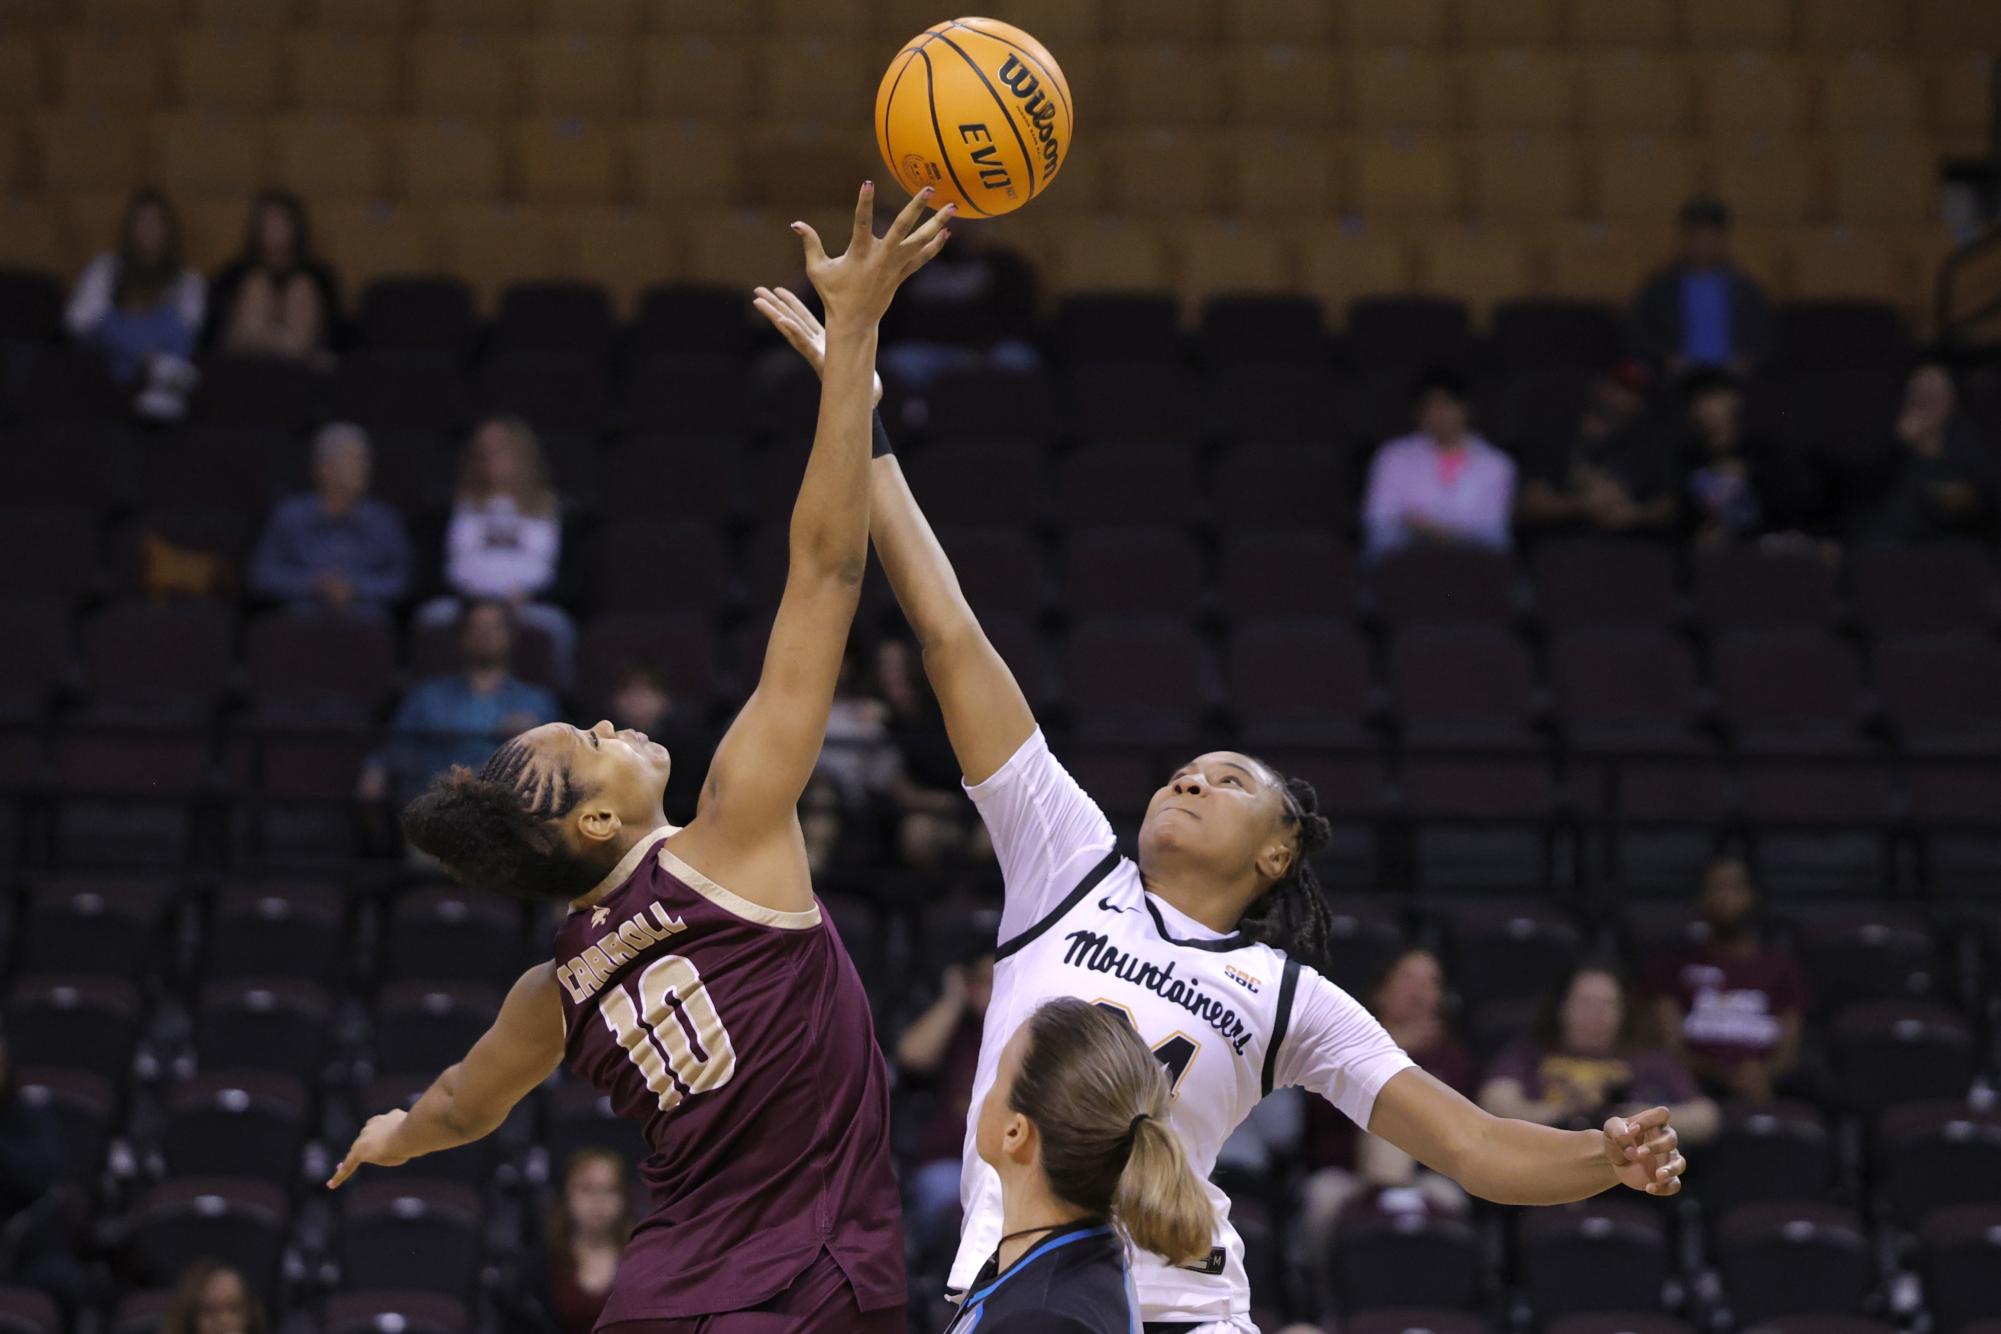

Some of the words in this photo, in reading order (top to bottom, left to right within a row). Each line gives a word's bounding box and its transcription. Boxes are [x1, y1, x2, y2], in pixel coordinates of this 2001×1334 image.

[958, 123, 1012, 190] EVO
[998, 53, 1058, 180] Wilson
[557, 901, 688, 1005] CARROLL
[1064, 930, 1252, 1056] Mountaineers
[599, 954, 737, 1112] 10
